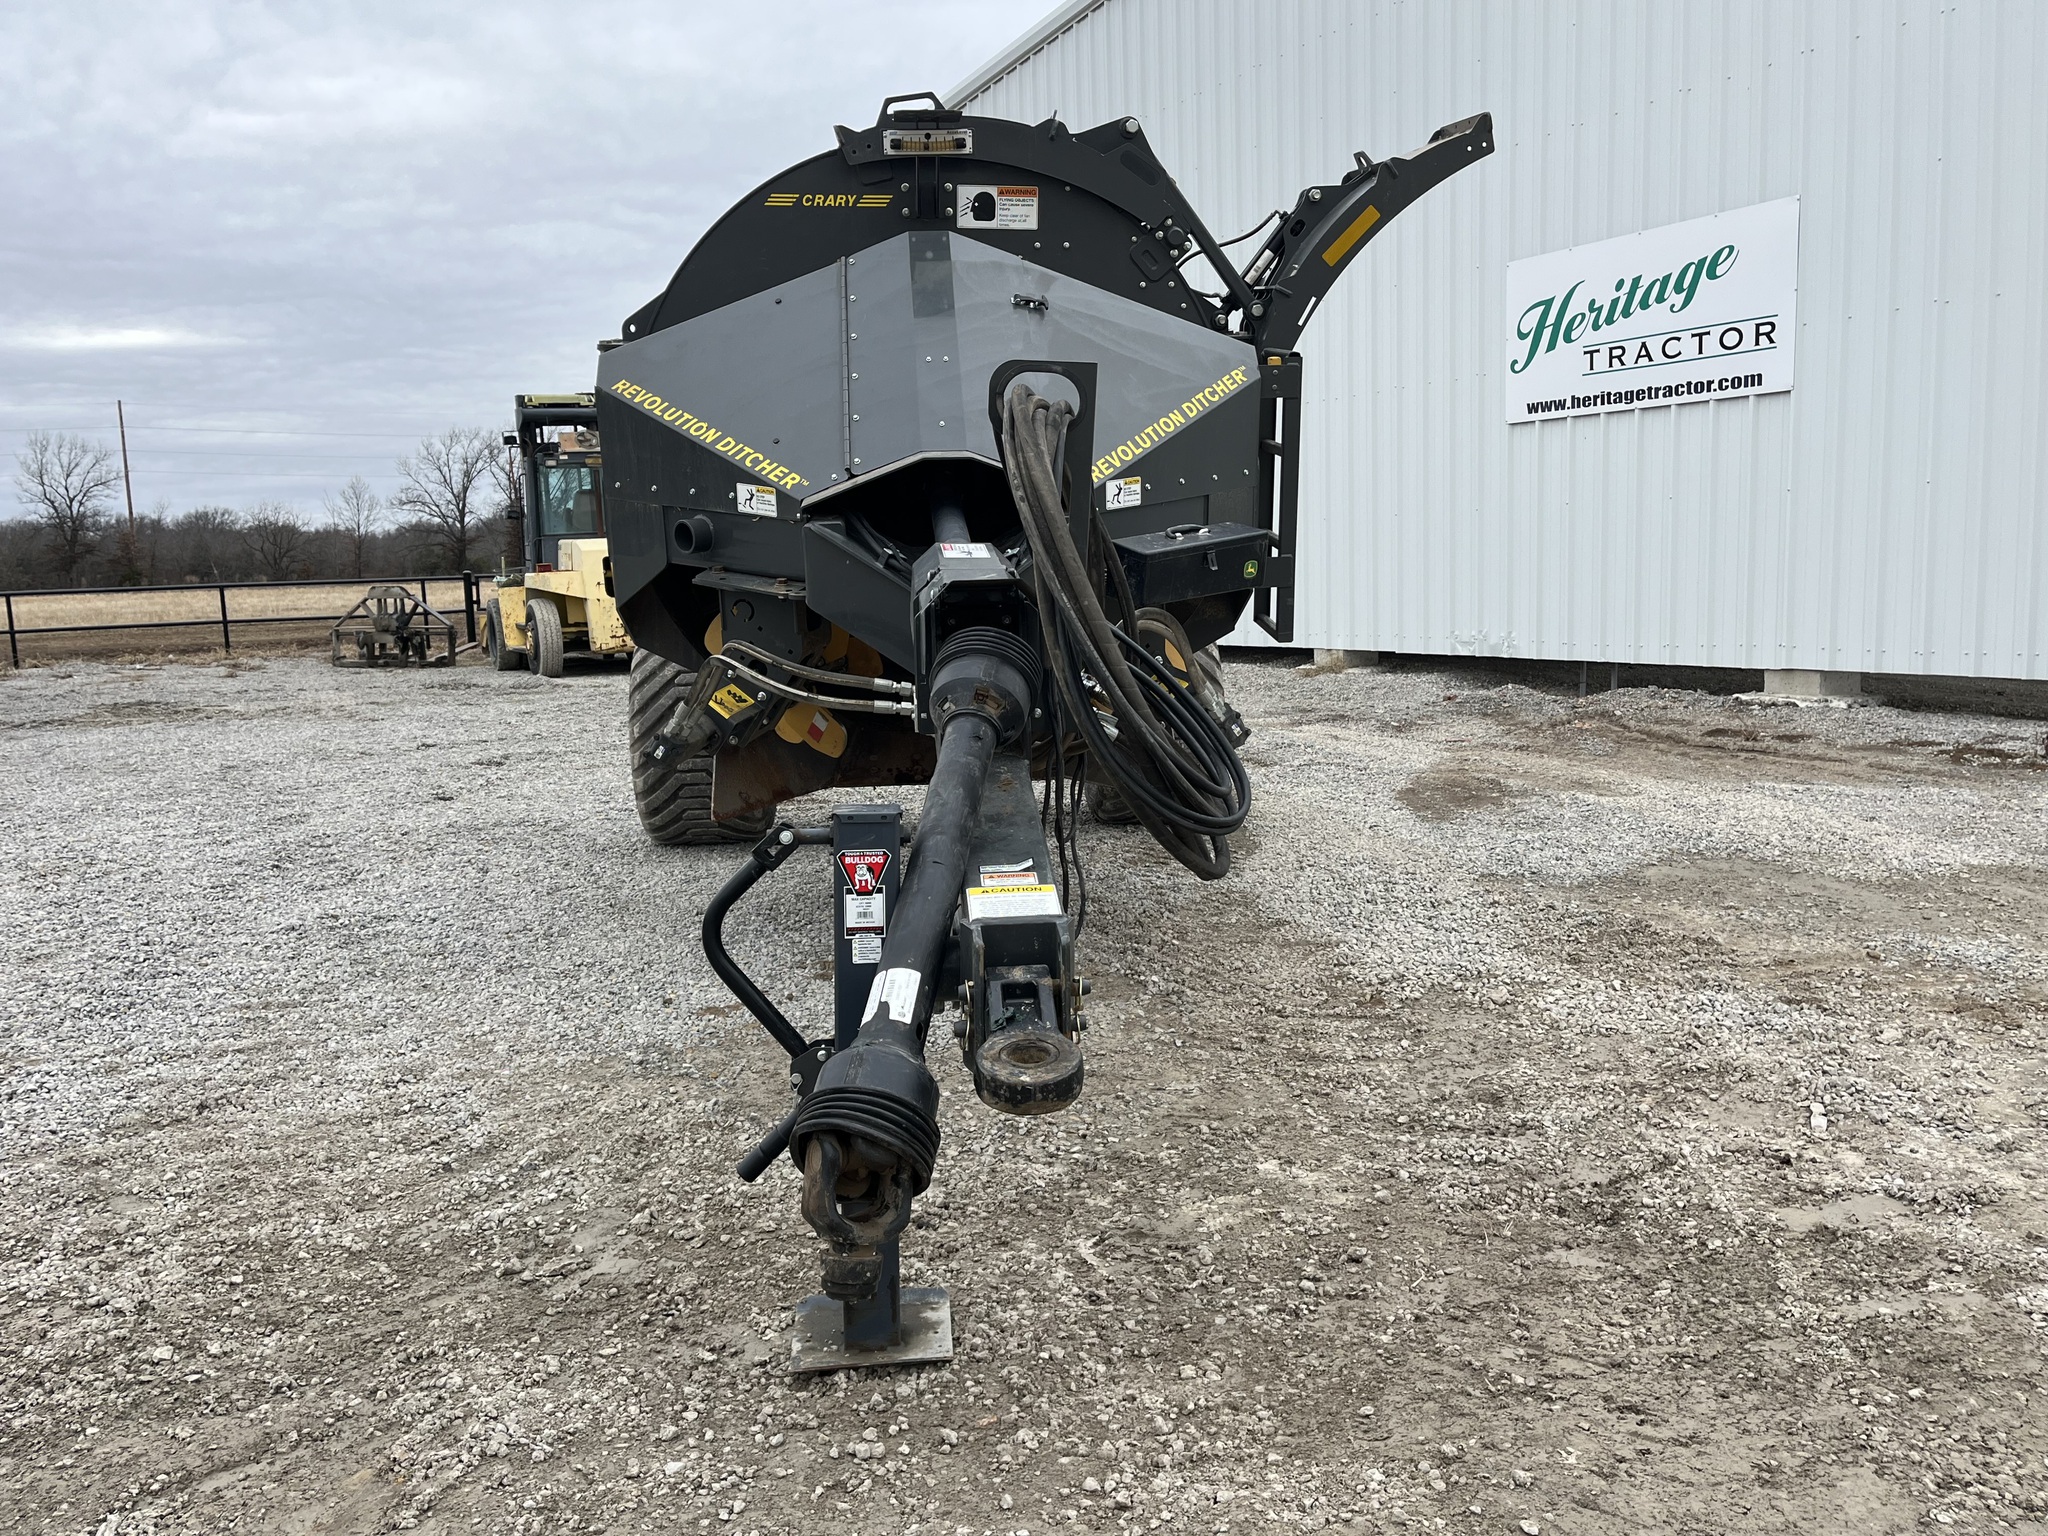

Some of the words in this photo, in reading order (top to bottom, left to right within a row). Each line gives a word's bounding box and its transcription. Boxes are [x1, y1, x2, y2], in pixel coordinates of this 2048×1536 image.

[802, 194, 858, 207] CRARY
[1005, 188, 1037, 196] WARNING
[1510, 244, 1740, 374] Heritage
[1583, 320, 1778, 372] TRACTOR
[610, 379, 722, 444] REVOLUTION
[1526, 372, 1763, 415] www.heritagetractor.com
[1091, 409, 1186, 483] REVOLUTION
[845, 856, 884, 864] BULLDOG
